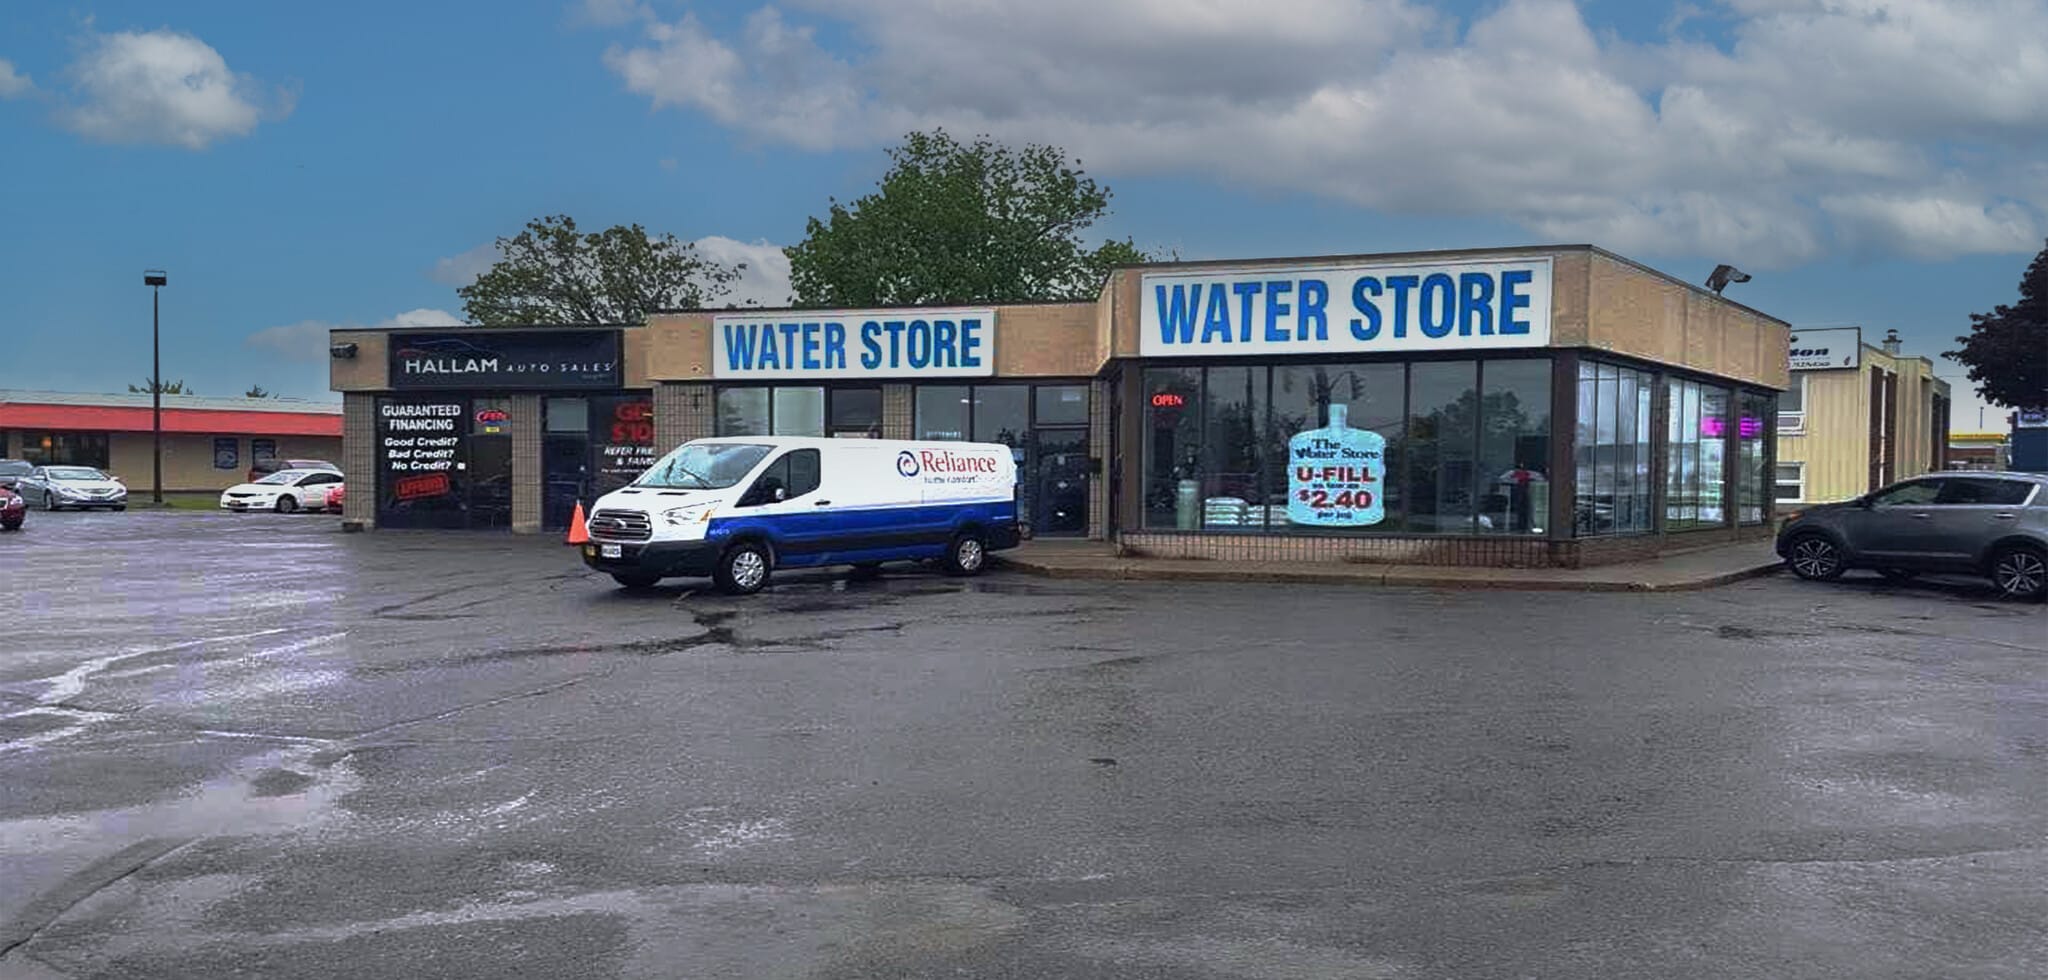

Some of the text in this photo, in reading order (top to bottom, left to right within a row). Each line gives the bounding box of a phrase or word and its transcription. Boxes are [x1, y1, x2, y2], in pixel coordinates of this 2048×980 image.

[1155, 269, 1531, 344] WATER STORE
[724, 319, 981, 370] WATER STORE
[405, 358, 611, 373] HALLAM AUTO SALES
[1152, 394, 1182, 406] OPEN
[382, 405, 461, 416] GUARANTEED
[615, 404, 653, 420] GE
[389, 419, 453, 430] FINANCING
[385, 437, 458, 446] Good Credit?
[1311, 439, 1340, 449] The
[388, 450, 454, 458] Bad Credit?
[604, 447, 633, 455] REFER
[1295, 447, 1378, 458] Water Store
[391, 461, 452, 470] No Credit?
[920, 450, 996, 472] Reliance
[1297, 467, 1376, 482] U-FILL
[1298, 489, 1371, 509] $2.40
